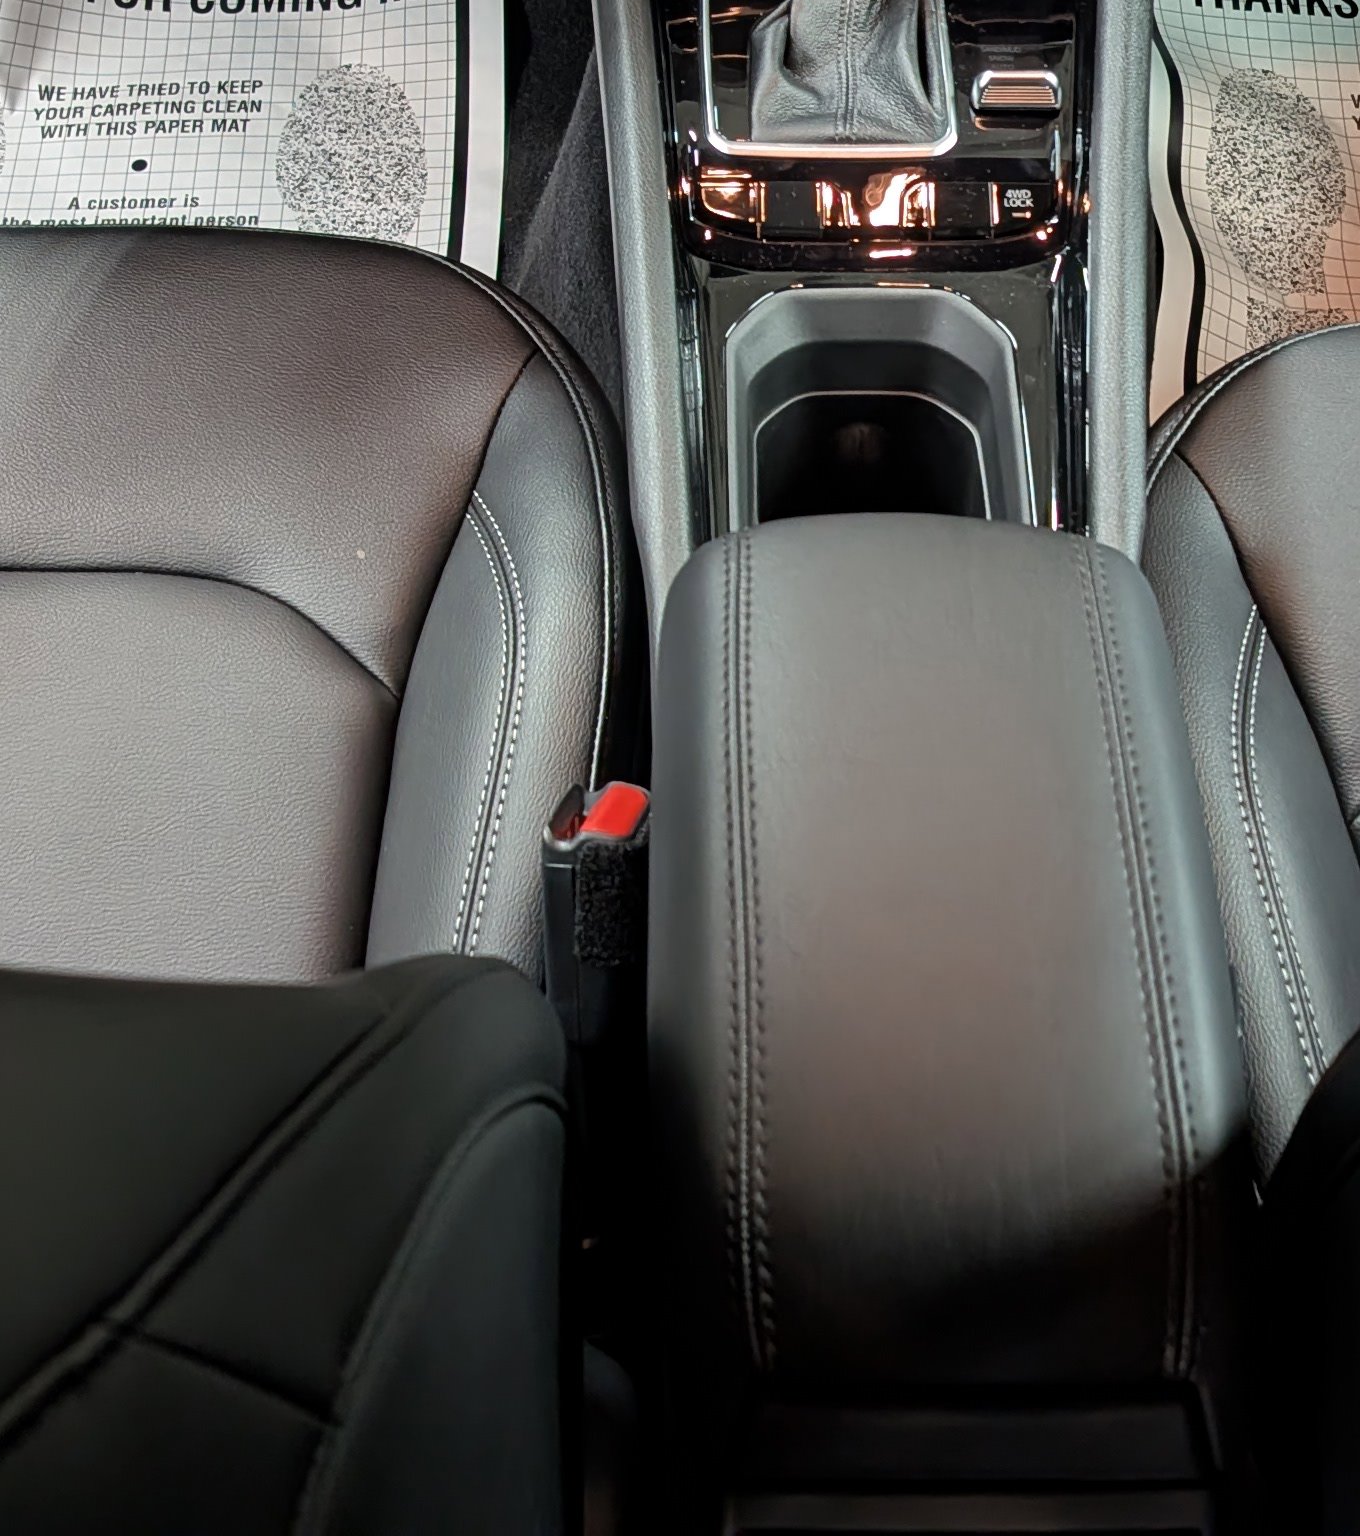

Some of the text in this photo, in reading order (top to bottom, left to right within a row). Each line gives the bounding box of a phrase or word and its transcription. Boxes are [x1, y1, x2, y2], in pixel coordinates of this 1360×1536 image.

[38, 80, 263, 102] WE HAVE TRIED TO KEEP
[34, 99, 262, 121] YOUR CARPETING CLEAN
[41, 118, 251, 139] WITH THIS PAPER MAT
[68, 194, 200, 210] A customer is
[1004, 198, 1034, 207] LOCK
[1005, 189, 1031, 198] 4WD
